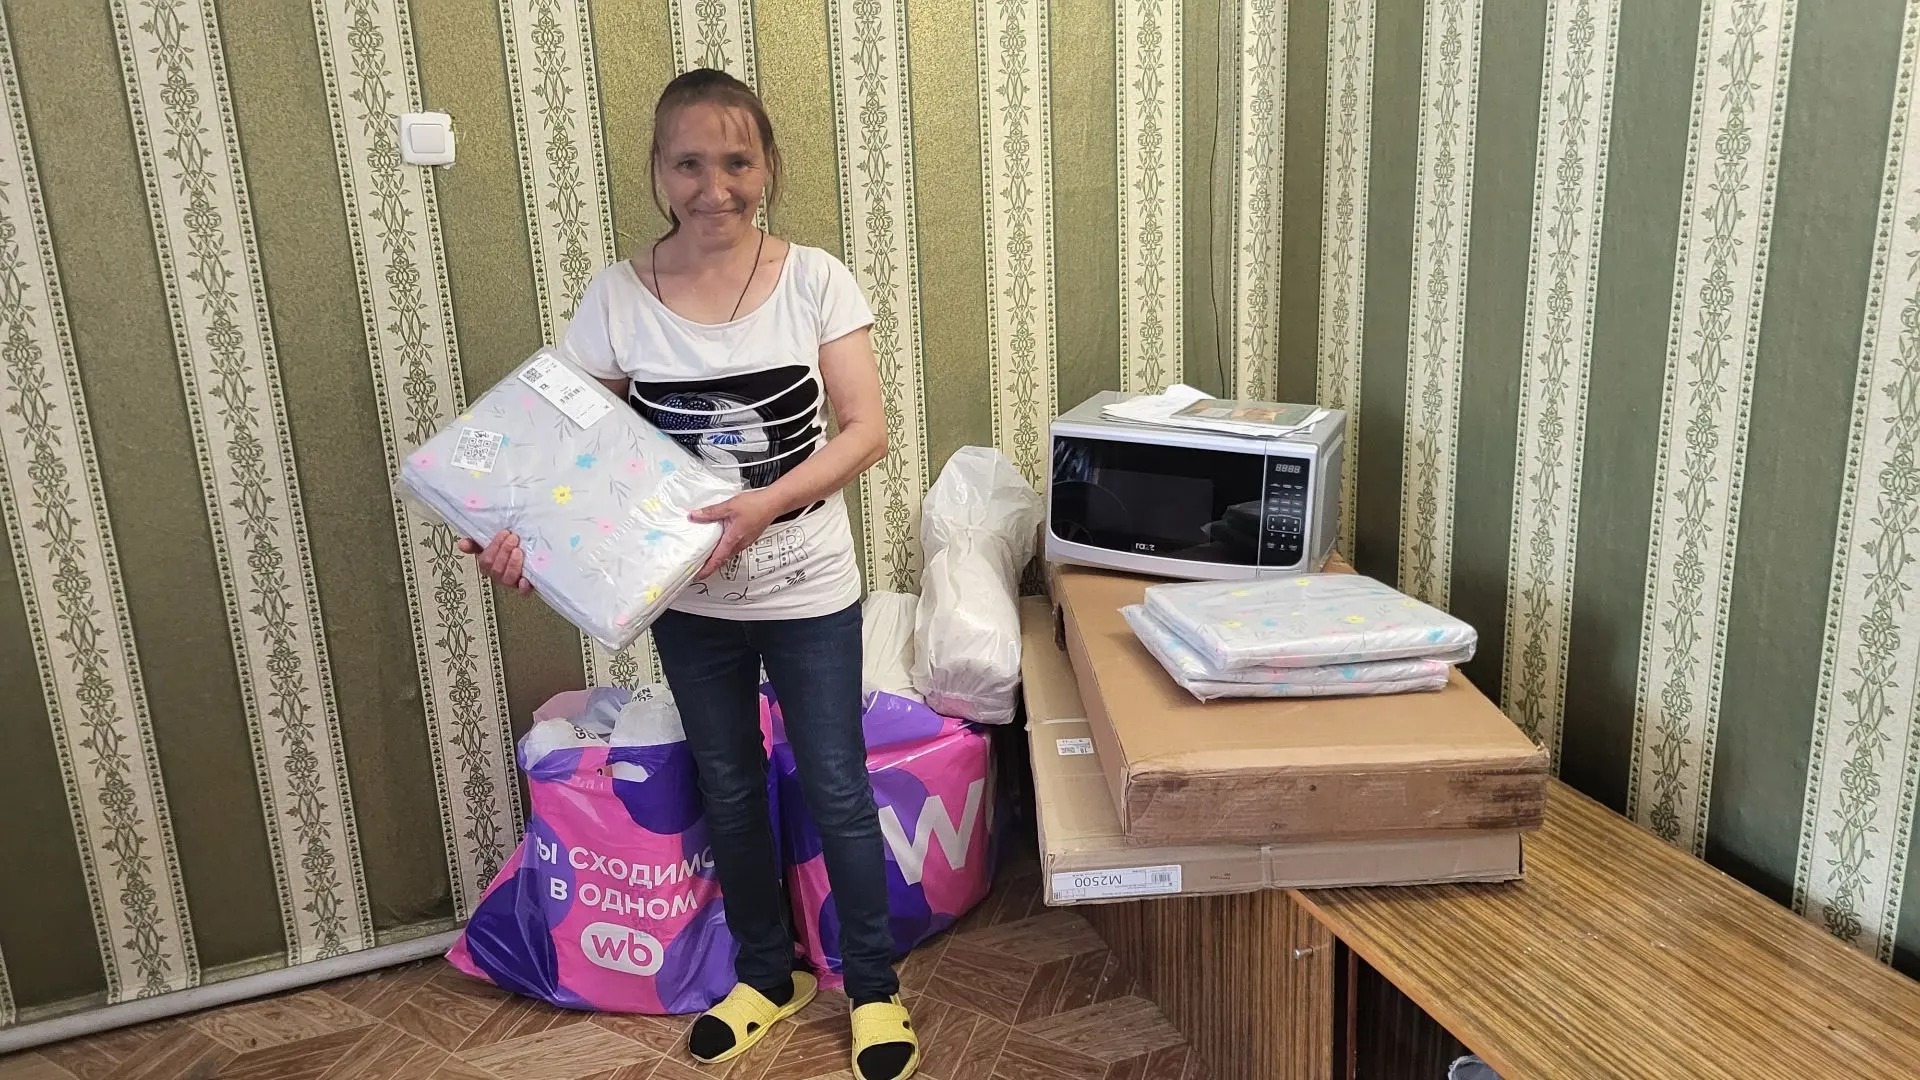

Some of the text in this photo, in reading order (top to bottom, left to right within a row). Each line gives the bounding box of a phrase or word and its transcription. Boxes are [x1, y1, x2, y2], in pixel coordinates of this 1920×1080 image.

[550, 876, 698, 921] В ОДНОМ
[1074, 875, 1122, 888] M2500
[591, 932, 653, 967] wb
